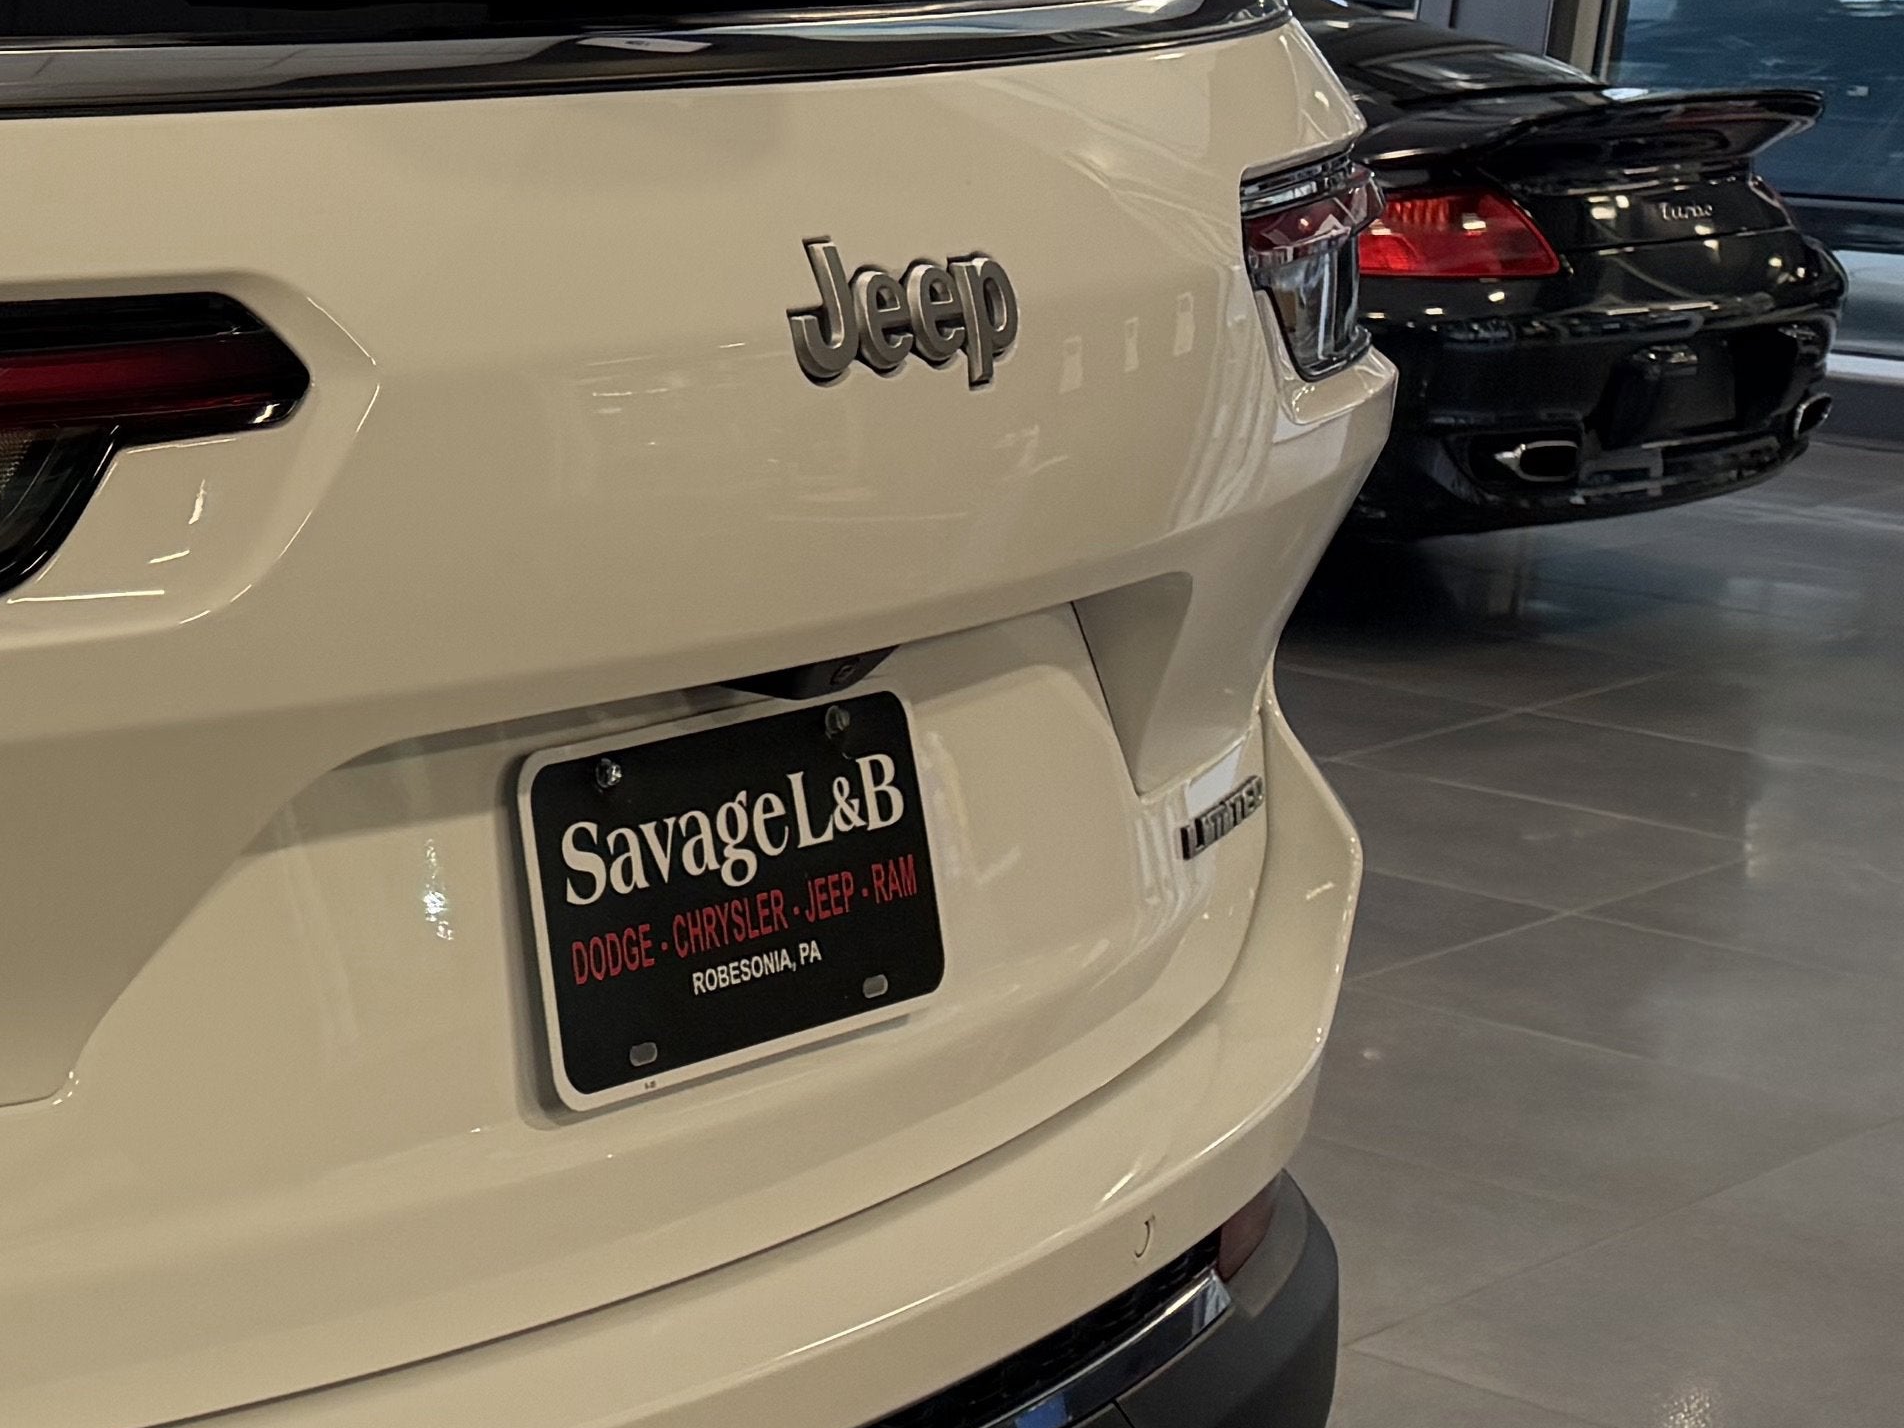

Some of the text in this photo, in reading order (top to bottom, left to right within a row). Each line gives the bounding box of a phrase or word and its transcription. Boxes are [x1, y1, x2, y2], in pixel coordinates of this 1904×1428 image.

[786, 235, 1019, 391] Jeep
[571, 854, 917, 985] DODGE CHRYSLER JEEP RAM
[692, 940, 822, 995] ROBESONIA, PA
